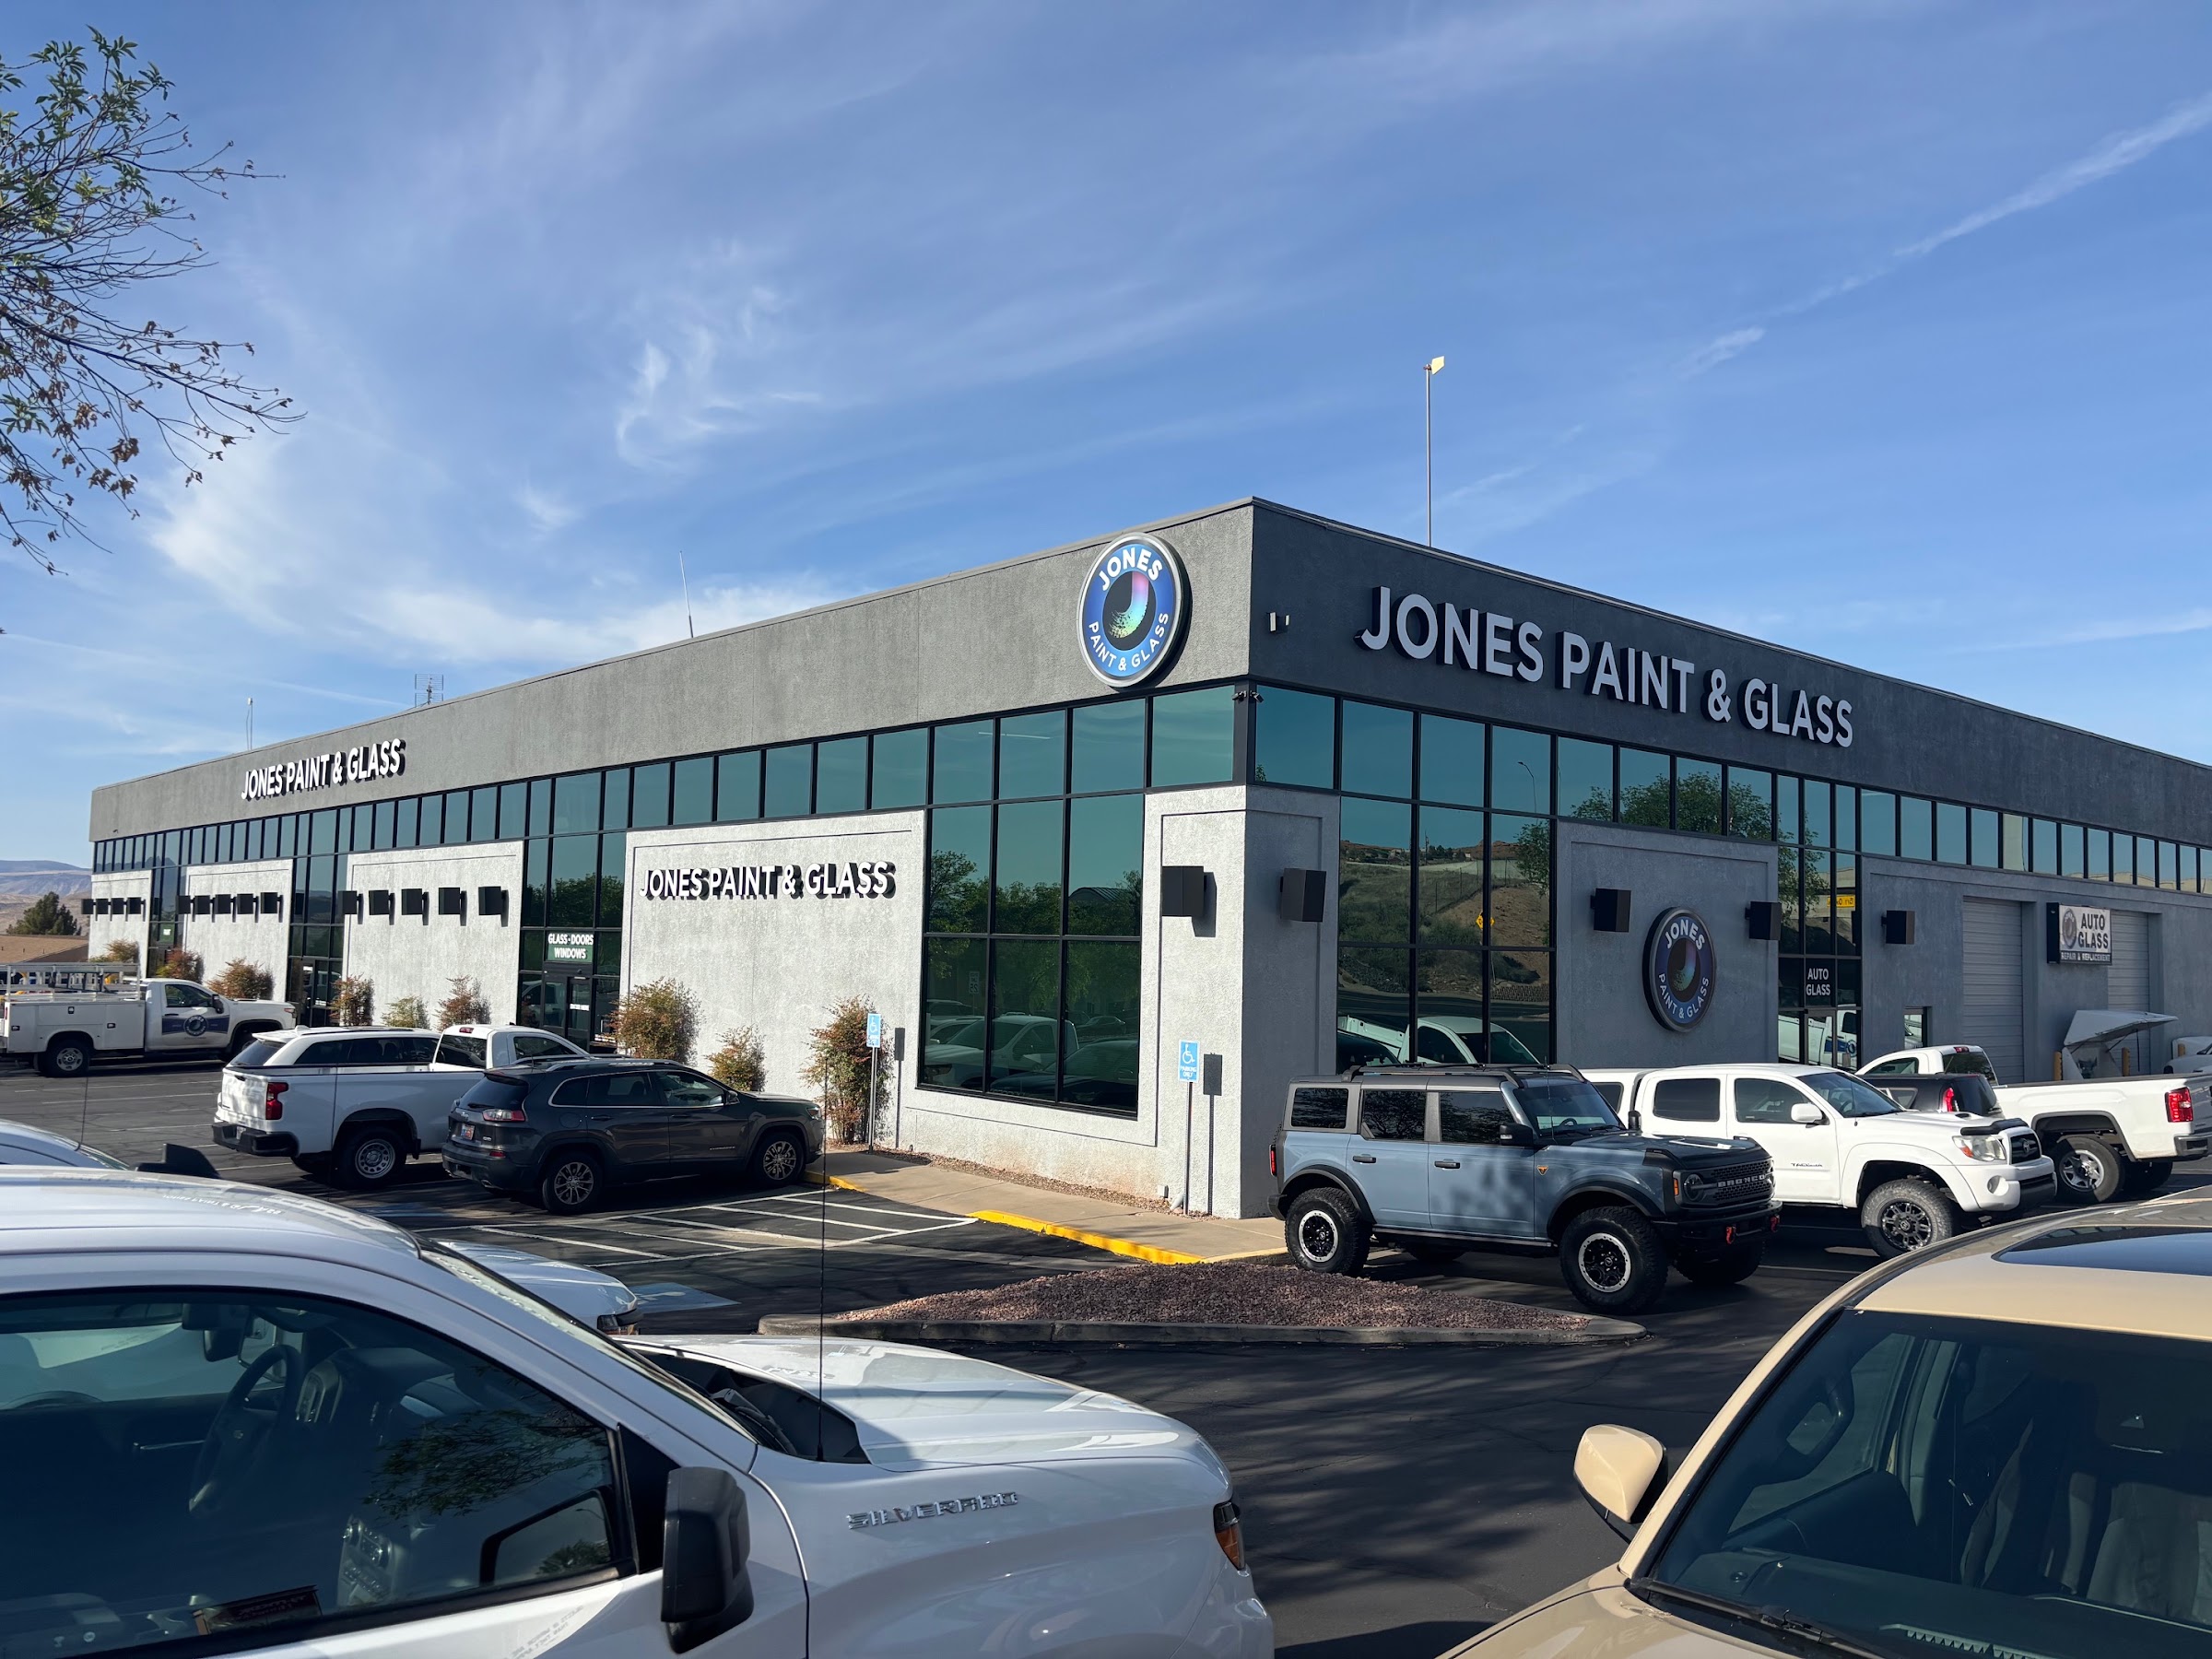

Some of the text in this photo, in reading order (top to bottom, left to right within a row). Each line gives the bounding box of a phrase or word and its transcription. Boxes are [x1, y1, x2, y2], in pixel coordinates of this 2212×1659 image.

[1099, 547, 1163, 592] JONES
[1088, 613, 1169, 671] PAINT & GLASS
[1359, 585, 1853, 748] JONES PAINT & GLASS
[241, 737, 403, 800] JONES PAINT & GLASS
[640, 861, 890, 898] JONES PAINT & GLASS
[1665, 919, 1705, 950] JONES
[2080, 912, 2106, 931] AUTO
[547, 933, 594, 946] GLASS DOORS
[554, 947, 587, 959] WINDOWS
[2077, 931, 2109, 949] GLASS
[1806, 968, 1830, 980] AUTO
[1806, 983, 1831, 996] GLASS
[1658, 973, 1710, 1018] PAINT & GLASS
[1717, 1173, 1766, 1188] BRONCO
[846, 1491, 1018, 1530] SILVERADO
